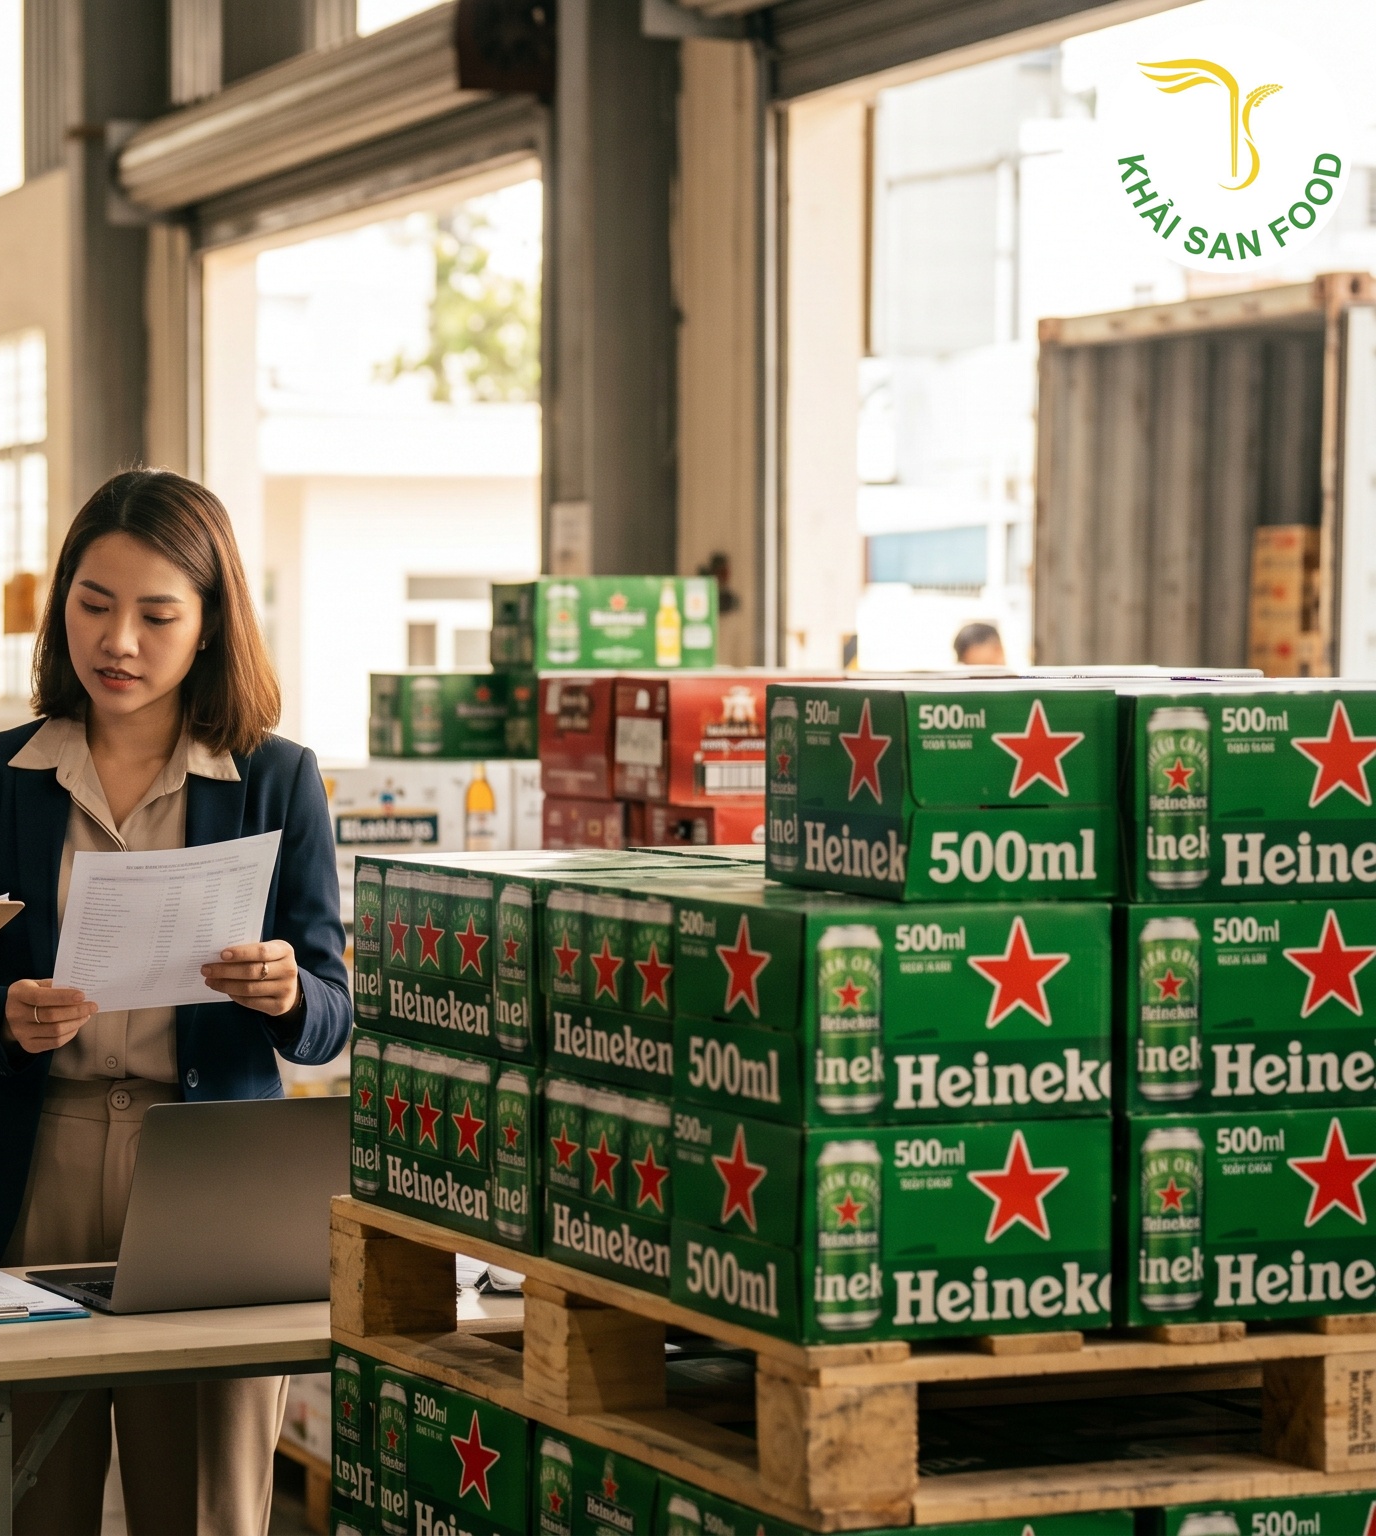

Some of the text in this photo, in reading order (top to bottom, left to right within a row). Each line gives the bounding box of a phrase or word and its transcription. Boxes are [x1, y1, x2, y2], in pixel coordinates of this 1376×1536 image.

[805, 700, 840, 725] 500ml
[918, 704, 987, 730] 500ml
[1222, 707, 1289, 733] 500ml
[928, 828, 1098, 884] 500ml
[1221, 830, 1376, 886] Heine
[679, 909, 717, 938] 500ml
[894, 923, 966, 952] 500ml
[1212, 916, 1281, 944] 500ml
[388, 978, 491, 1037] Heineken
[553, 1010, 674, 1077] Heineken
[688, 1035, 782, 1104] 500ml
[674, 1113, 713, 1147] 500ml
[1216, 1125, 1286, 1155] 500ml
[893, 1138, 966, 1168] 500ml
[386, 1154, 490, 1222] Heineken
[552, 1201, 671, 1279] Heineken
[686, 1240, 779, 1320] 500ml
[1213, 1249, 1376, 1308] Heine
[413, 1391, 448, 1425] 500ml
[1251, 1510, 1322, 1536] 500ml
